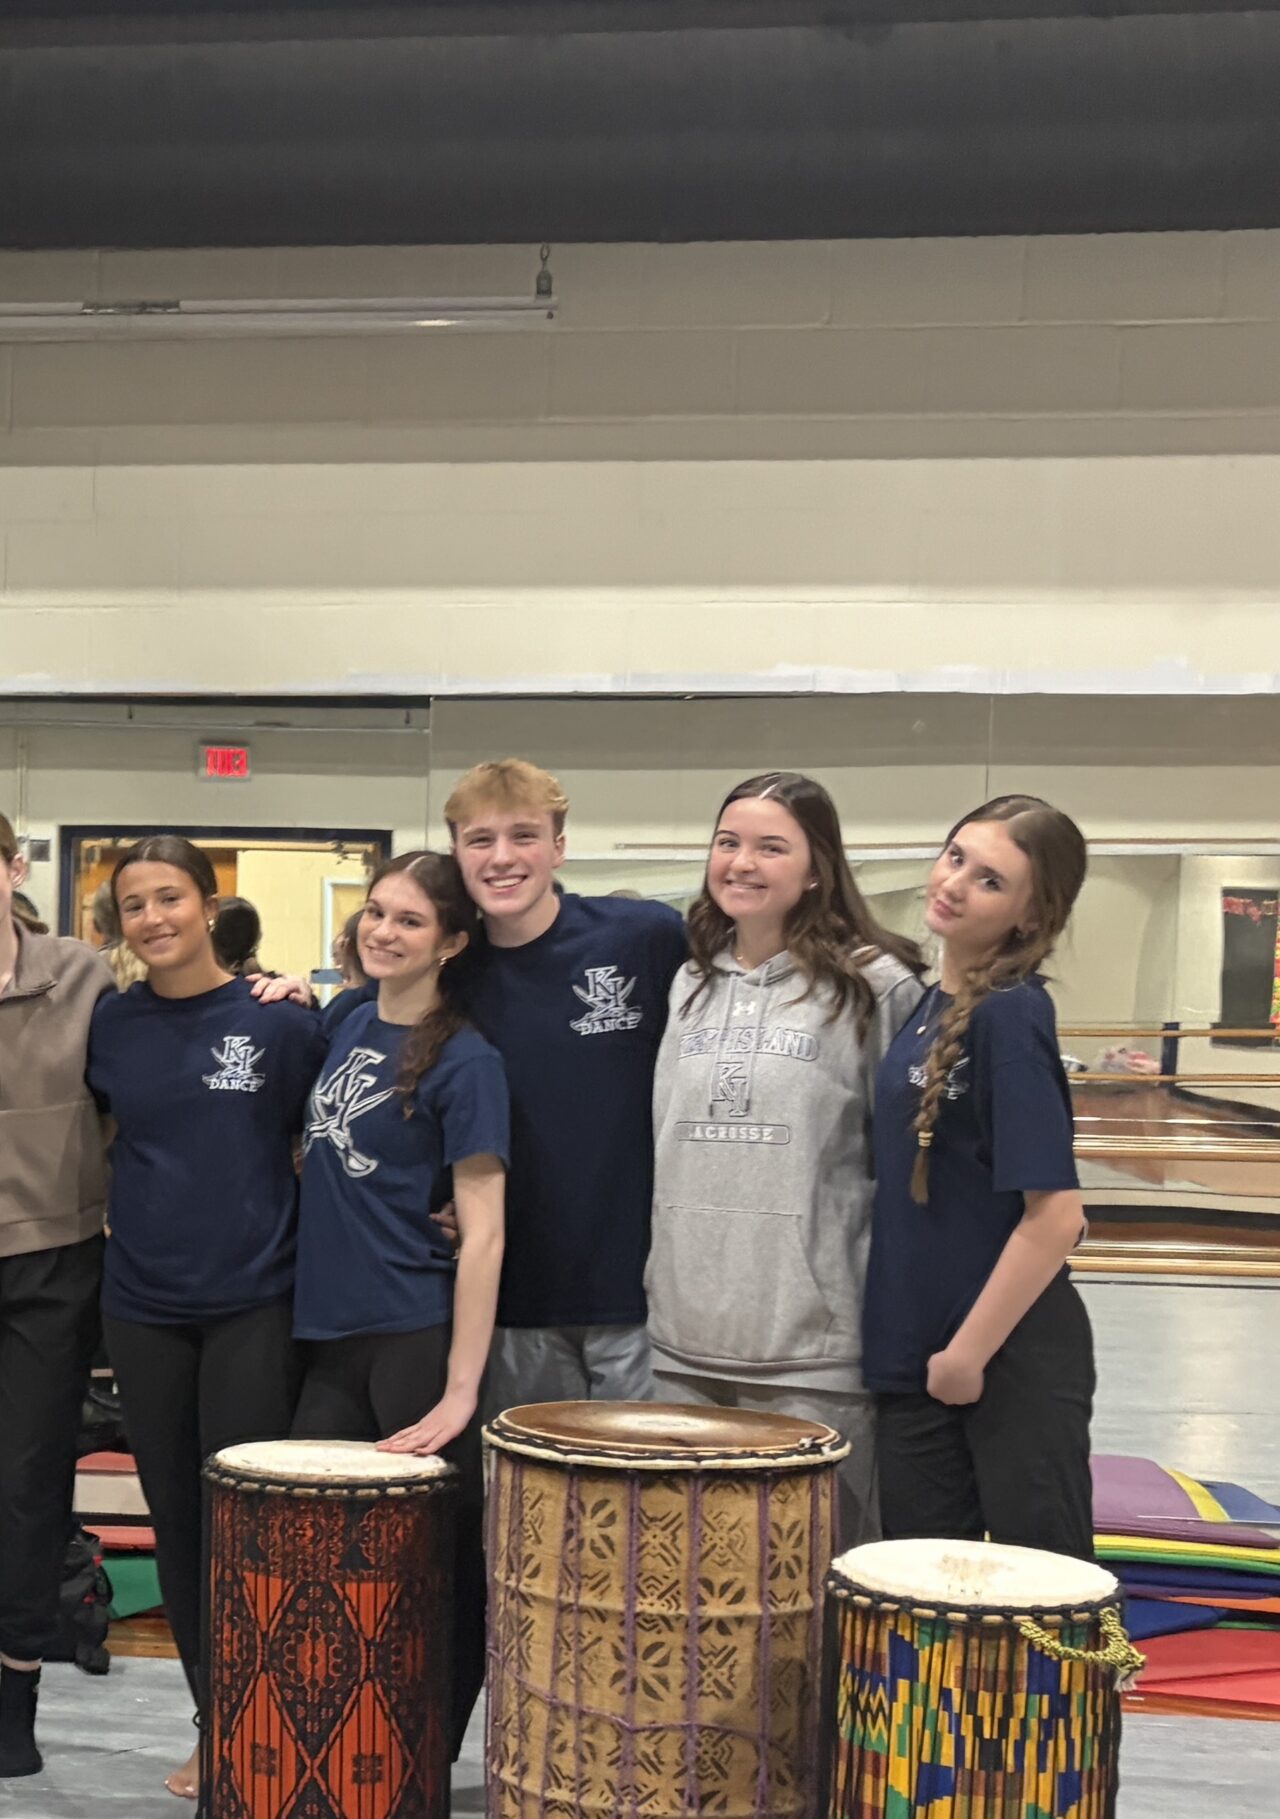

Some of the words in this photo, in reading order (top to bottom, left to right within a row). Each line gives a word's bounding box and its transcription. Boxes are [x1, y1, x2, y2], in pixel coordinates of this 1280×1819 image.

[576, 1017, 639, 1036] DANCE
[209, 1078, 258, 1093] DANCE
[688, 1125, 774, 1142] ACROSSE
